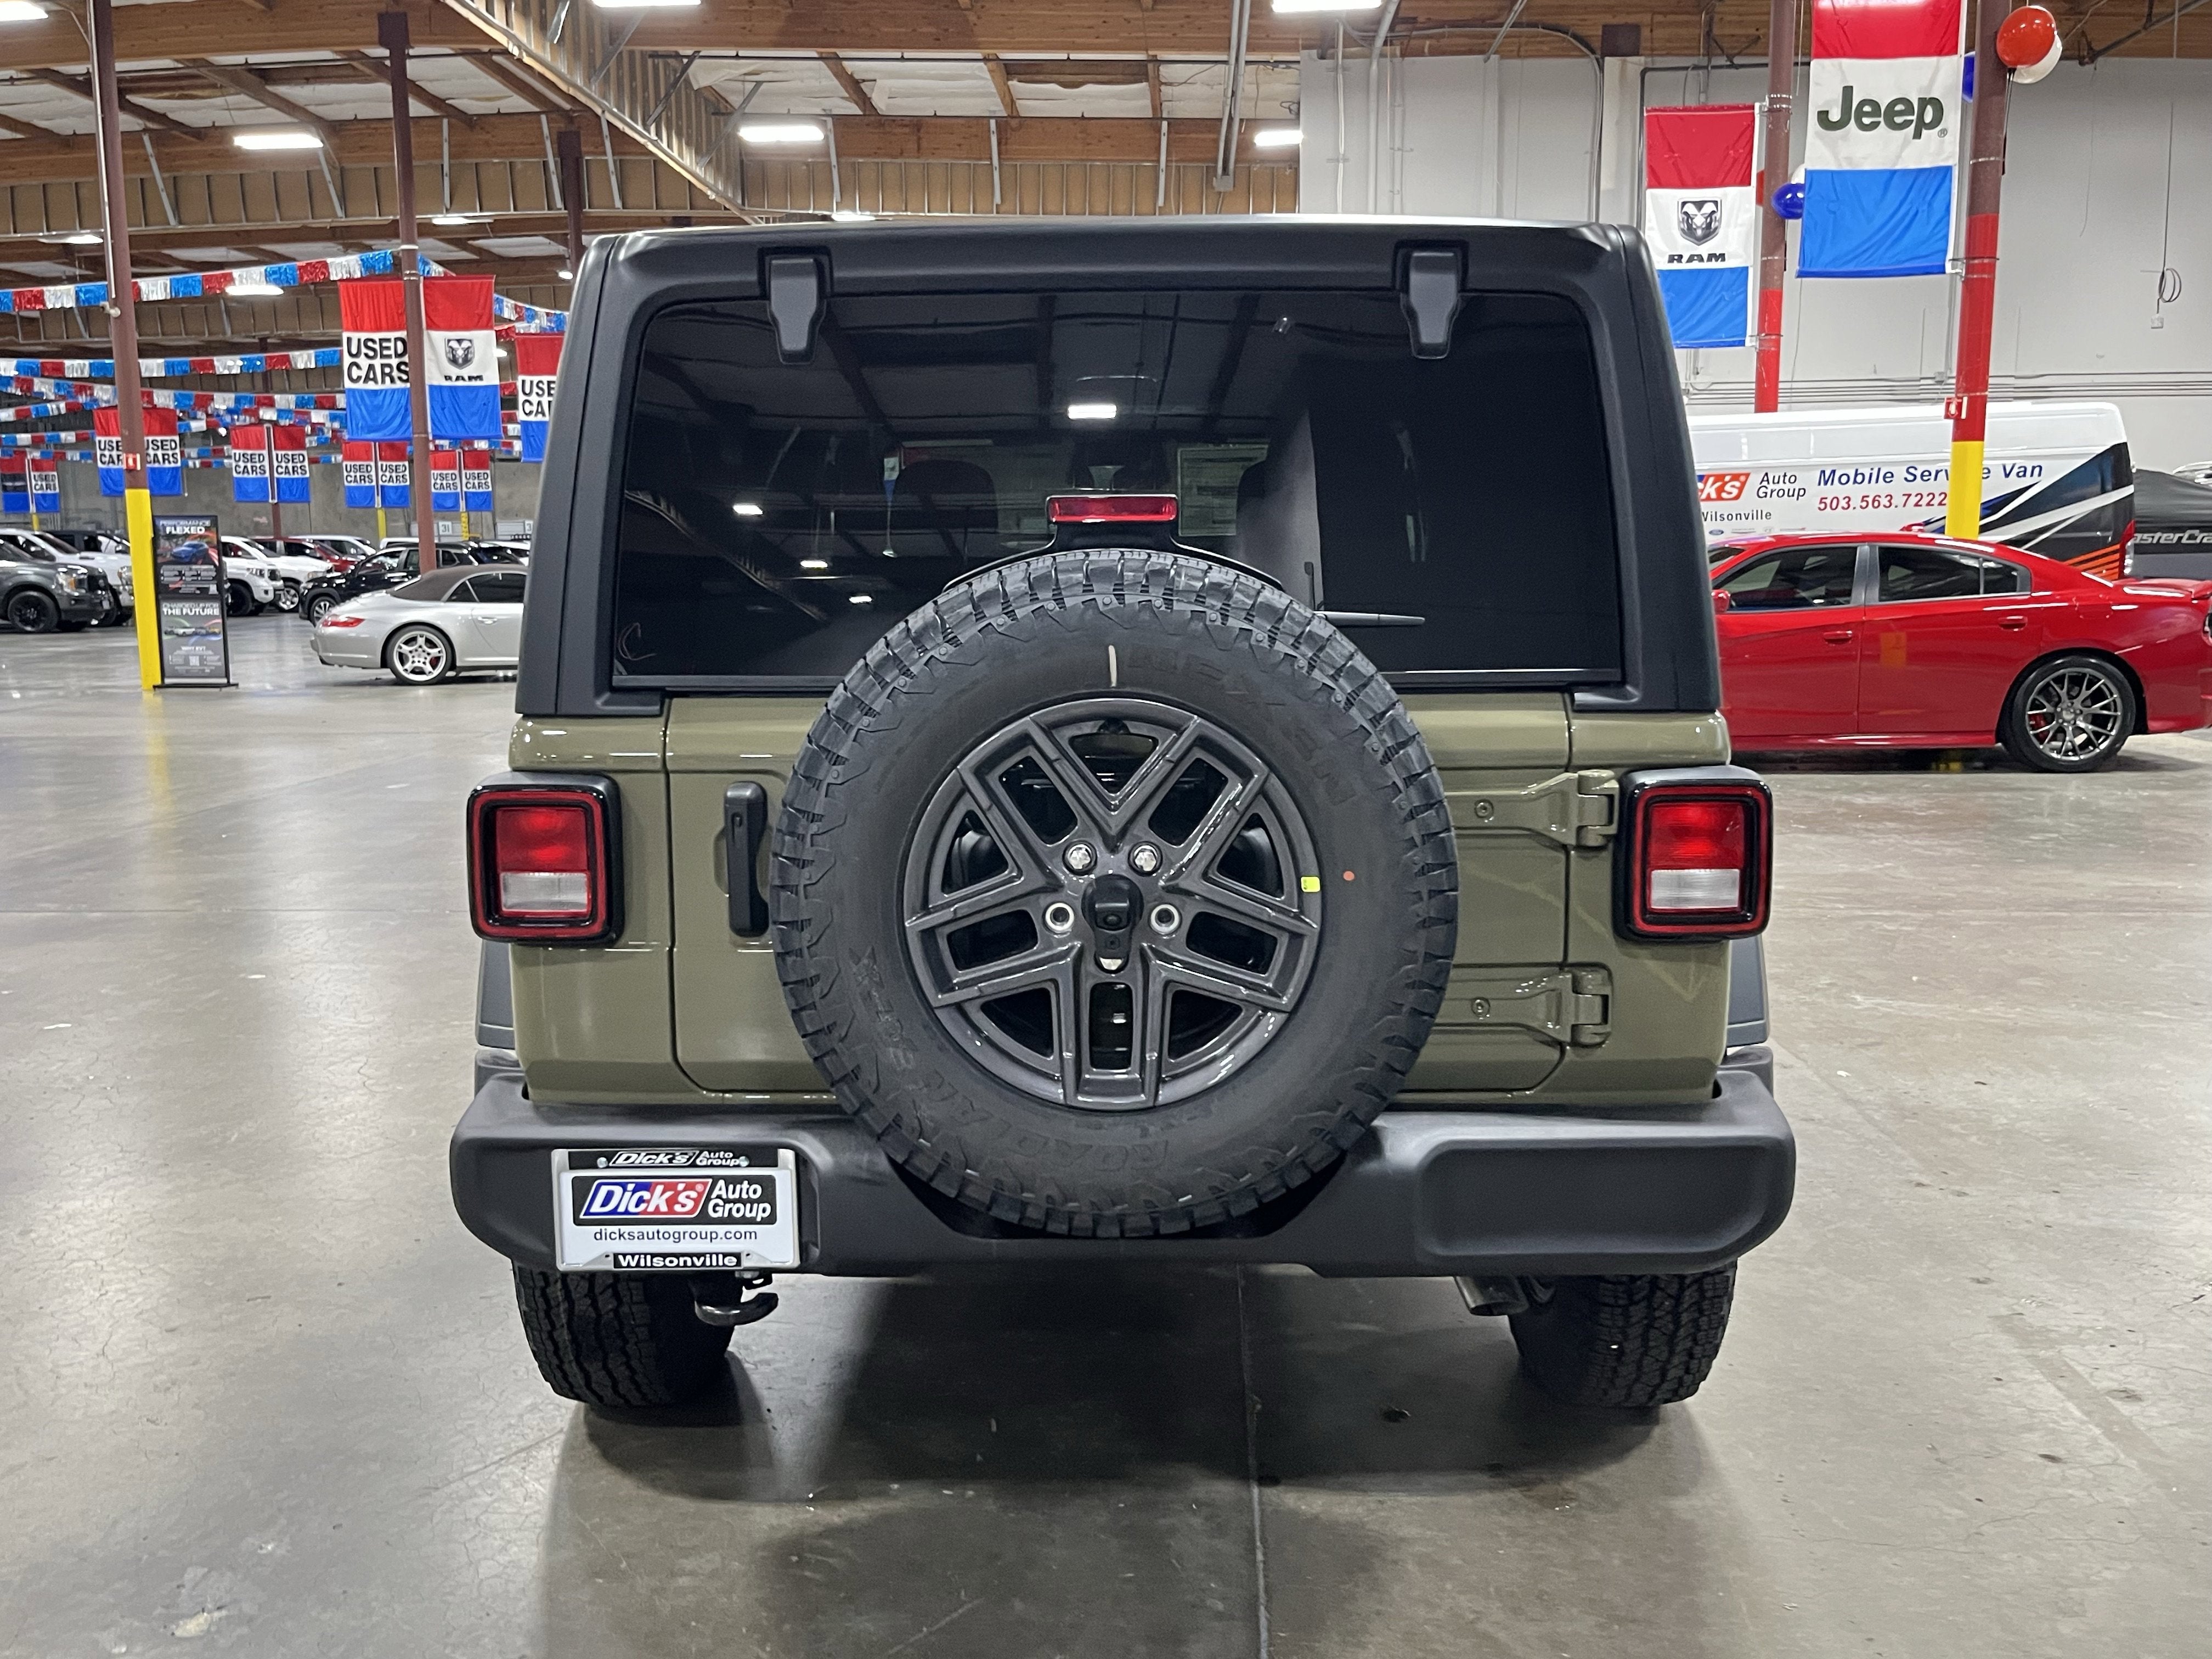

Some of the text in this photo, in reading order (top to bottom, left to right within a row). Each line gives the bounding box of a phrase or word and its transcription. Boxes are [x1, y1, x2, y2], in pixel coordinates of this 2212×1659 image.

[1816, 86, 1945, 139] Jeep
[1668, 252, 1726, 264] RAM
[347, 337, 408, 360] USED
[347, 361, 409, 385] CARS
[522, 379, 556, 398] USE
[522, 399, 552, 417] CA
[98, 440, 122, 452] USE
[99, 453, 122, 465] CAR
[234, 453, 264, 462] USED
[276, 453, 305, 464] USED
[235, 465, 266, 475] CARS
[276, 465, 307, 475] CARS
[345, 464, 372, 473] USED
[381, 464, 407, 473] USED
[33, 474, 55, 482] USED
[346, 474, 374, 483] CARS
[381, 474, 408, 483] CARS
[433, 473, 456, 481] USED
[465, 472, 488, 481] USED
[1759, 472, 1797, 485] Auto
[1818, 464, 2043, 486] Mobile Sere Van
[433, 482, 458, 490] CARS
[465, 481, 490, 489] CARS
[1757, 486, 1806, 500] Group
[1818, 492, 1948, 511] 503.563.7222
[2134, 529, 2212, 543] asterCra
[615, 1152, 690, 1164] Dick's
[696, 1158, 740, 1166] Group
[712, 1180, 762, 1199] Auto
[589, 1183, 698, 1212] Dick's
[708, 1199, 771, 1221] Group
[594, 1229, 758, 1243] dicksautogroup.com
[618, 1254, 737, 1267] Wilsonville
